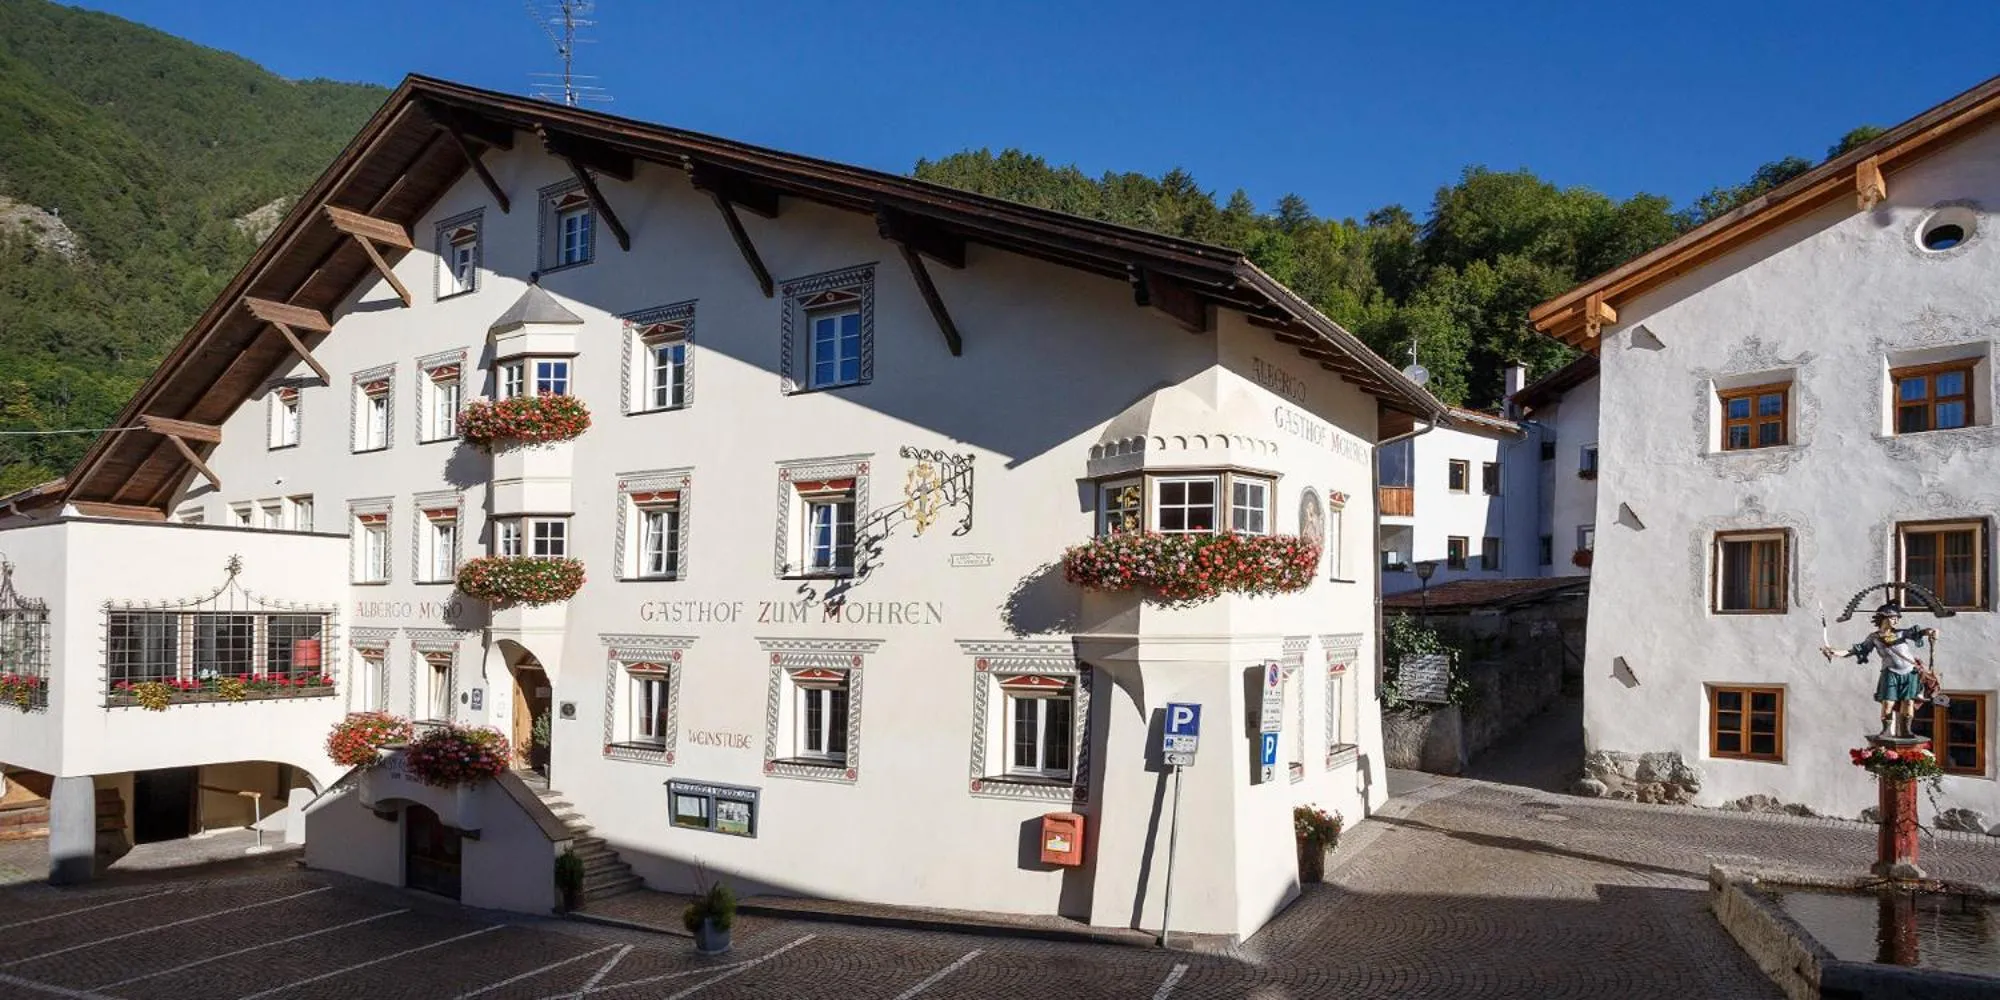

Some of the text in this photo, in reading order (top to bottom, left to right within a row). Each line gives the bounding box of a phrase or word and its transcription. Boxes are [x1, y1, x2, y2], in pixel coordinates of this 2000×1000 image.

[1252, 356, 1306, 403] ALBERGO
[1274, 406, 1369, 466] GASTHOF MOHREN
[356, 600, 463, 619] ALBERGO MORO
[640, 600, 944, 625] GASTHOF ZUM MOHREN
[1171, 706, 1194, 733] P
[688, 728, 752, 749] WEINSTUBE
[1265, 736, 1275, 763] P
